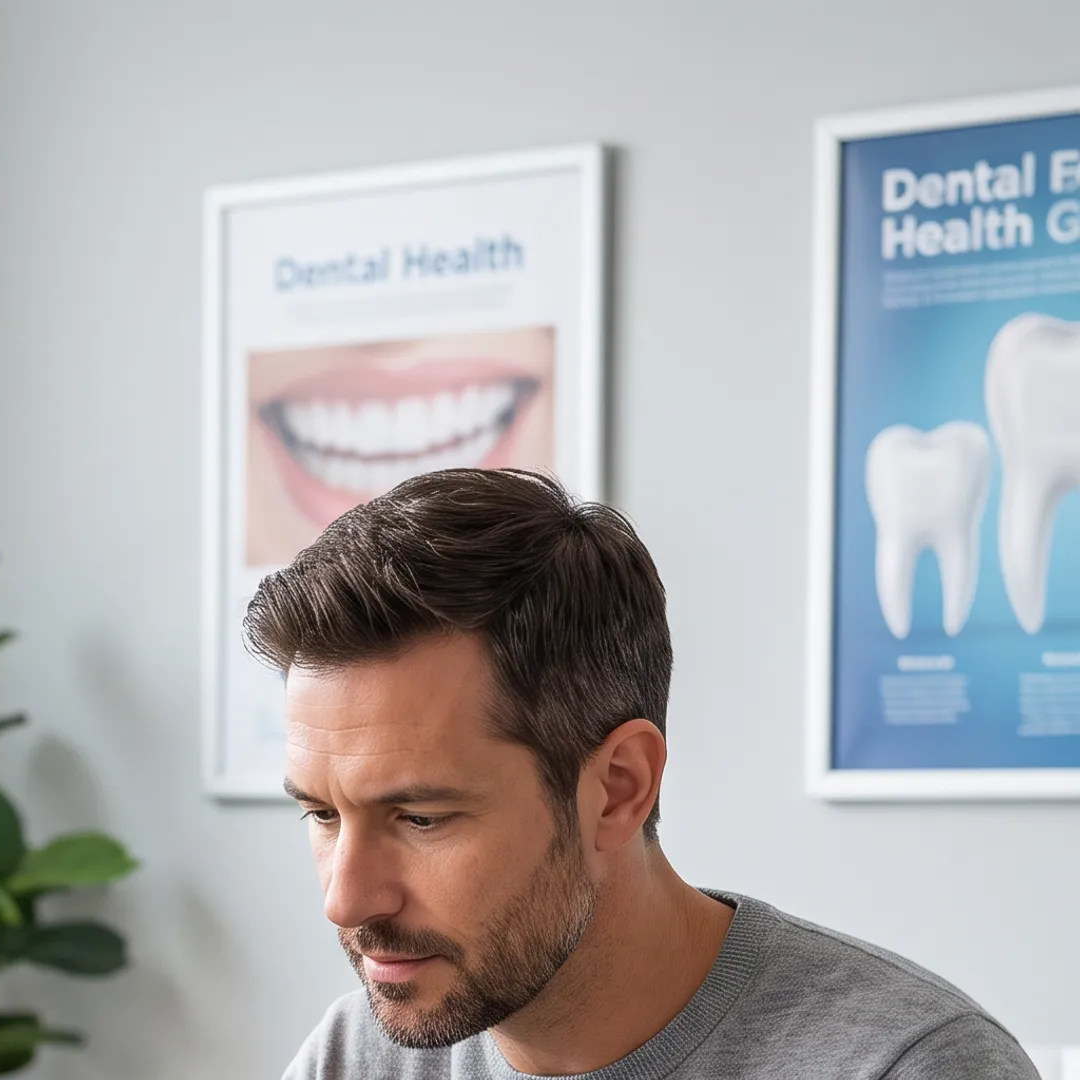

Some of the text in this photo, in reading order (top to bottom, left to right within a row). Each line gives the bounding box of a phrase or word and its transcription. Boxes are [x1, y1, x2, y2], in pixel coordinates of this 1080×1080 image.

[882, 148, 1080, 212] Dental F
[881, 202, 1033, 260] Health
[274, 233, 525, 292] Dental Health
